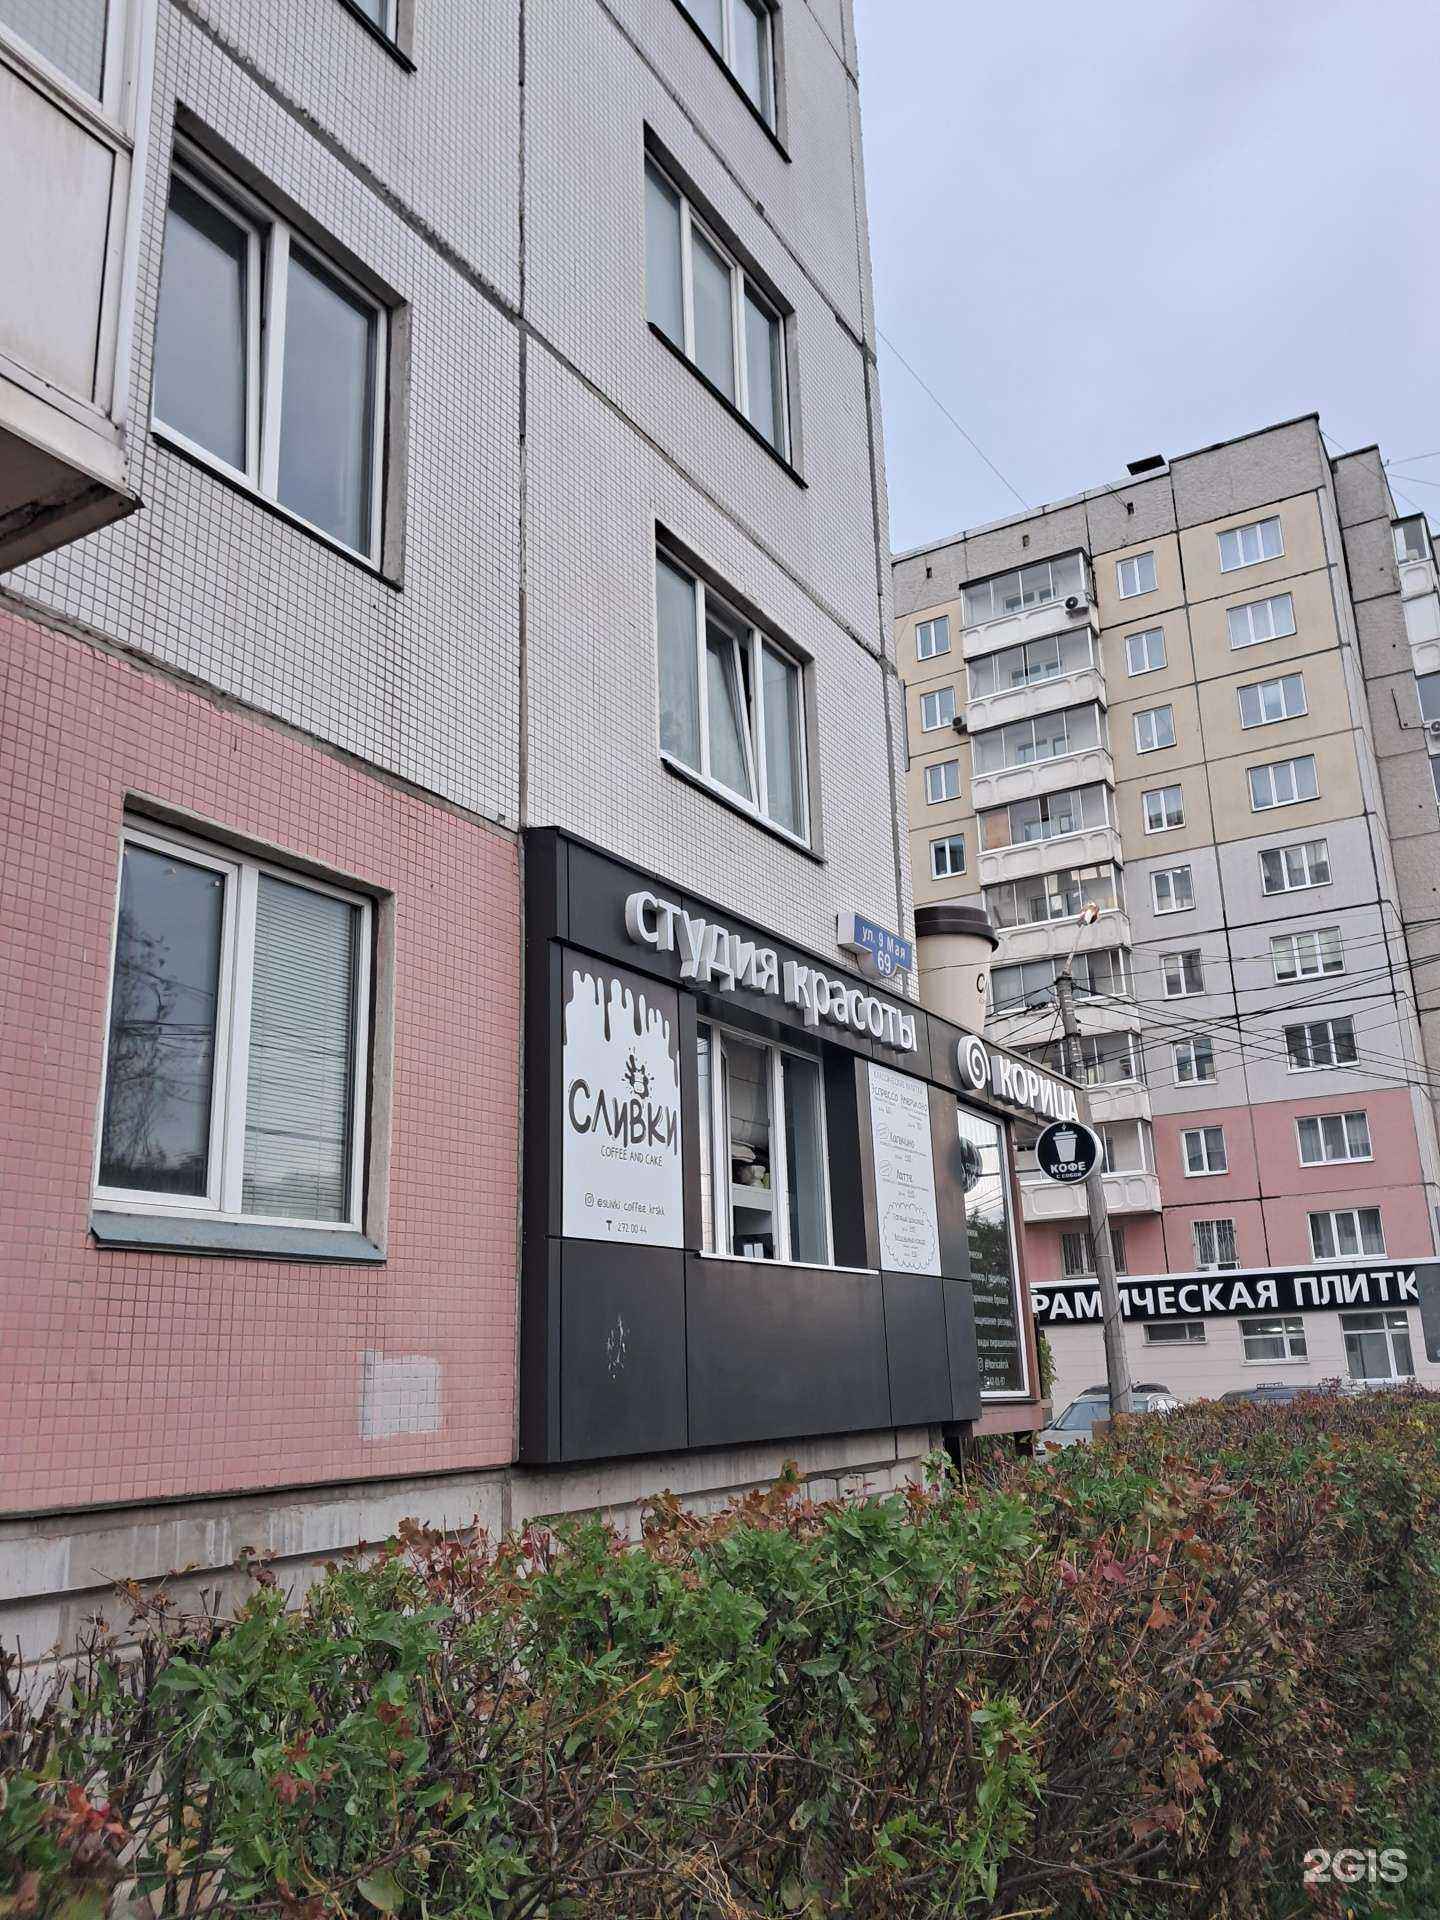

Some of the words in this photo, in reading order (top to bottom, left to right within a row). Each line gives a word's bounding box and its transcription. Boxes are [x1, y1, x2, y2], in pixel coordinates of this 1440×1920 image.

[862, 926, 876, 944] ул.
[878, 932, 884, 948] 9
[886, 937, 906, 962] Мая
[877, 950, 891, 974] 69
[782, 960, 918, 1052] красоты
[991, 1055, 1079, 1123] КОРИЦА
[600, 1145, 628, 1162] COFFEE
[629, 1151, 644, 1165] AND
[645, 1154, 663, 1168] CAKE
[1050, 1161, 1087, 1174] КОФЕ
